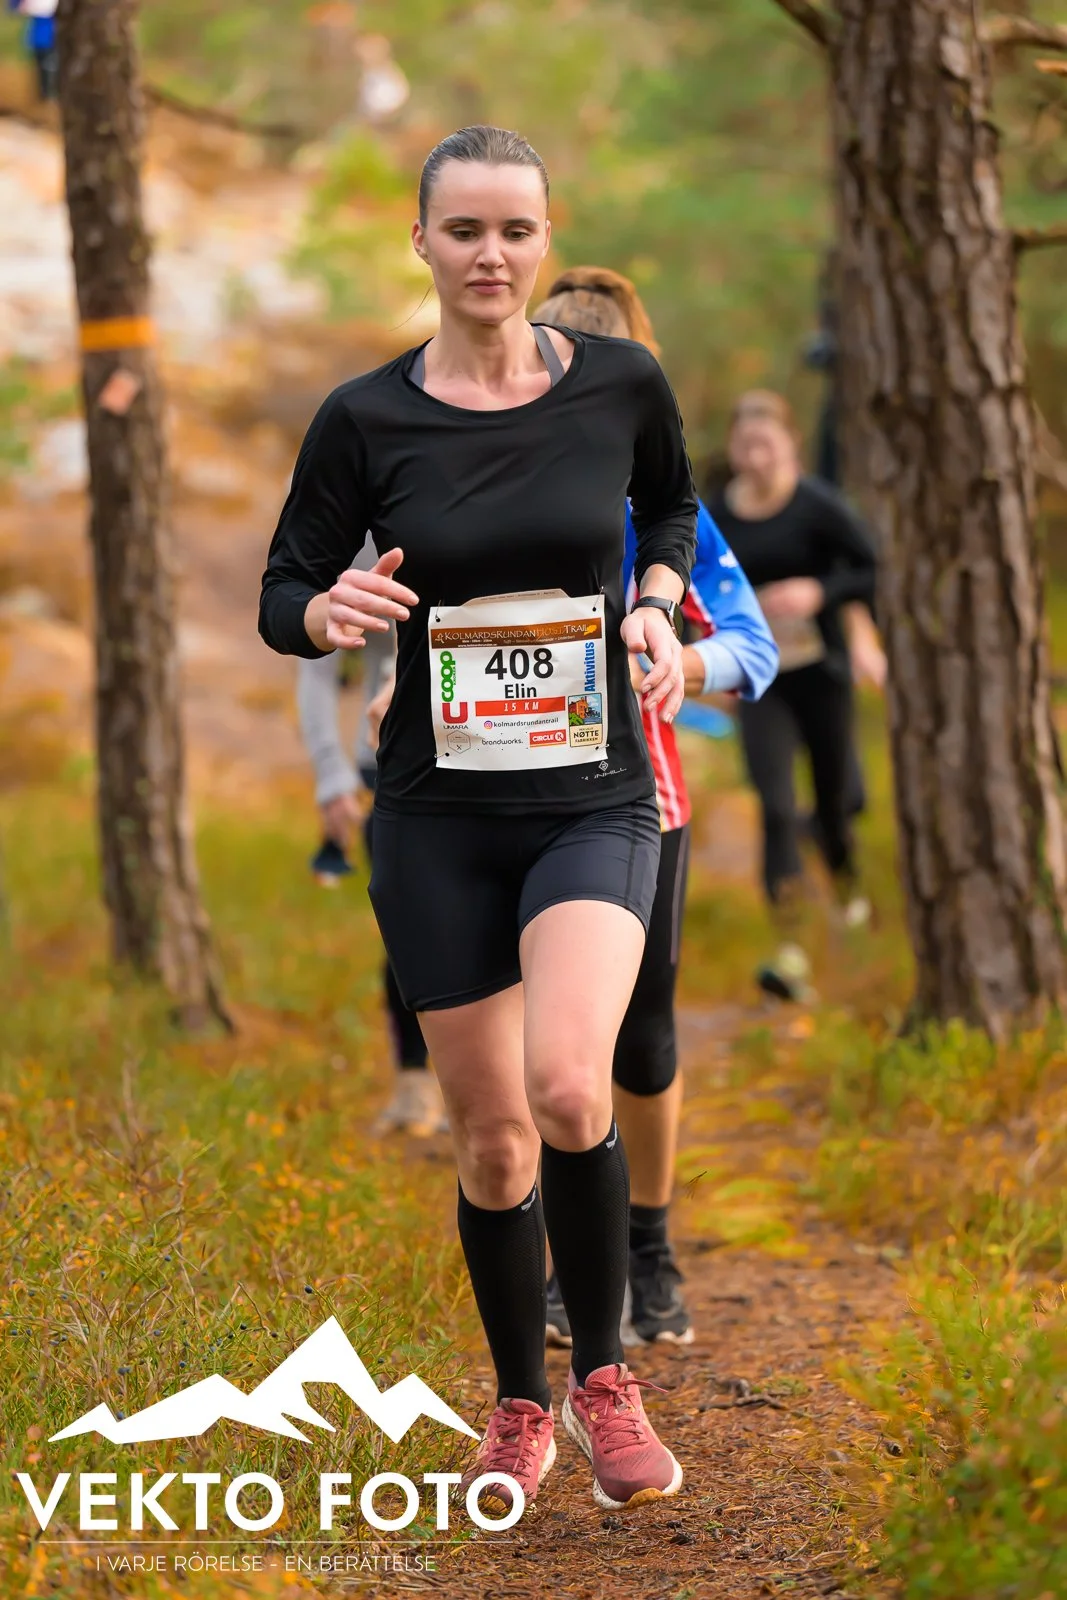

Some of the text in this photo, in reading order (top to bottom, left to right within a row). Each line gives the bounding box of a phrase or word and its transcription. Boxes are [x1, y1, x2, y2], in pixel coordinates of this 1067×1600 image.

[485, 648, 554, 680] 408
[584, 641, 595, 691] Aktivitus
[440, 650, 456, 702] coop
[504, 683, 537, 699] Elin
[504, 701, 539, 712] 15 KM
[493, 717, 559, 728] kolmardsrundantrail
[532, 734, 554, 742] CIRCLE
[573, 729, 600, 739] NØTTE
